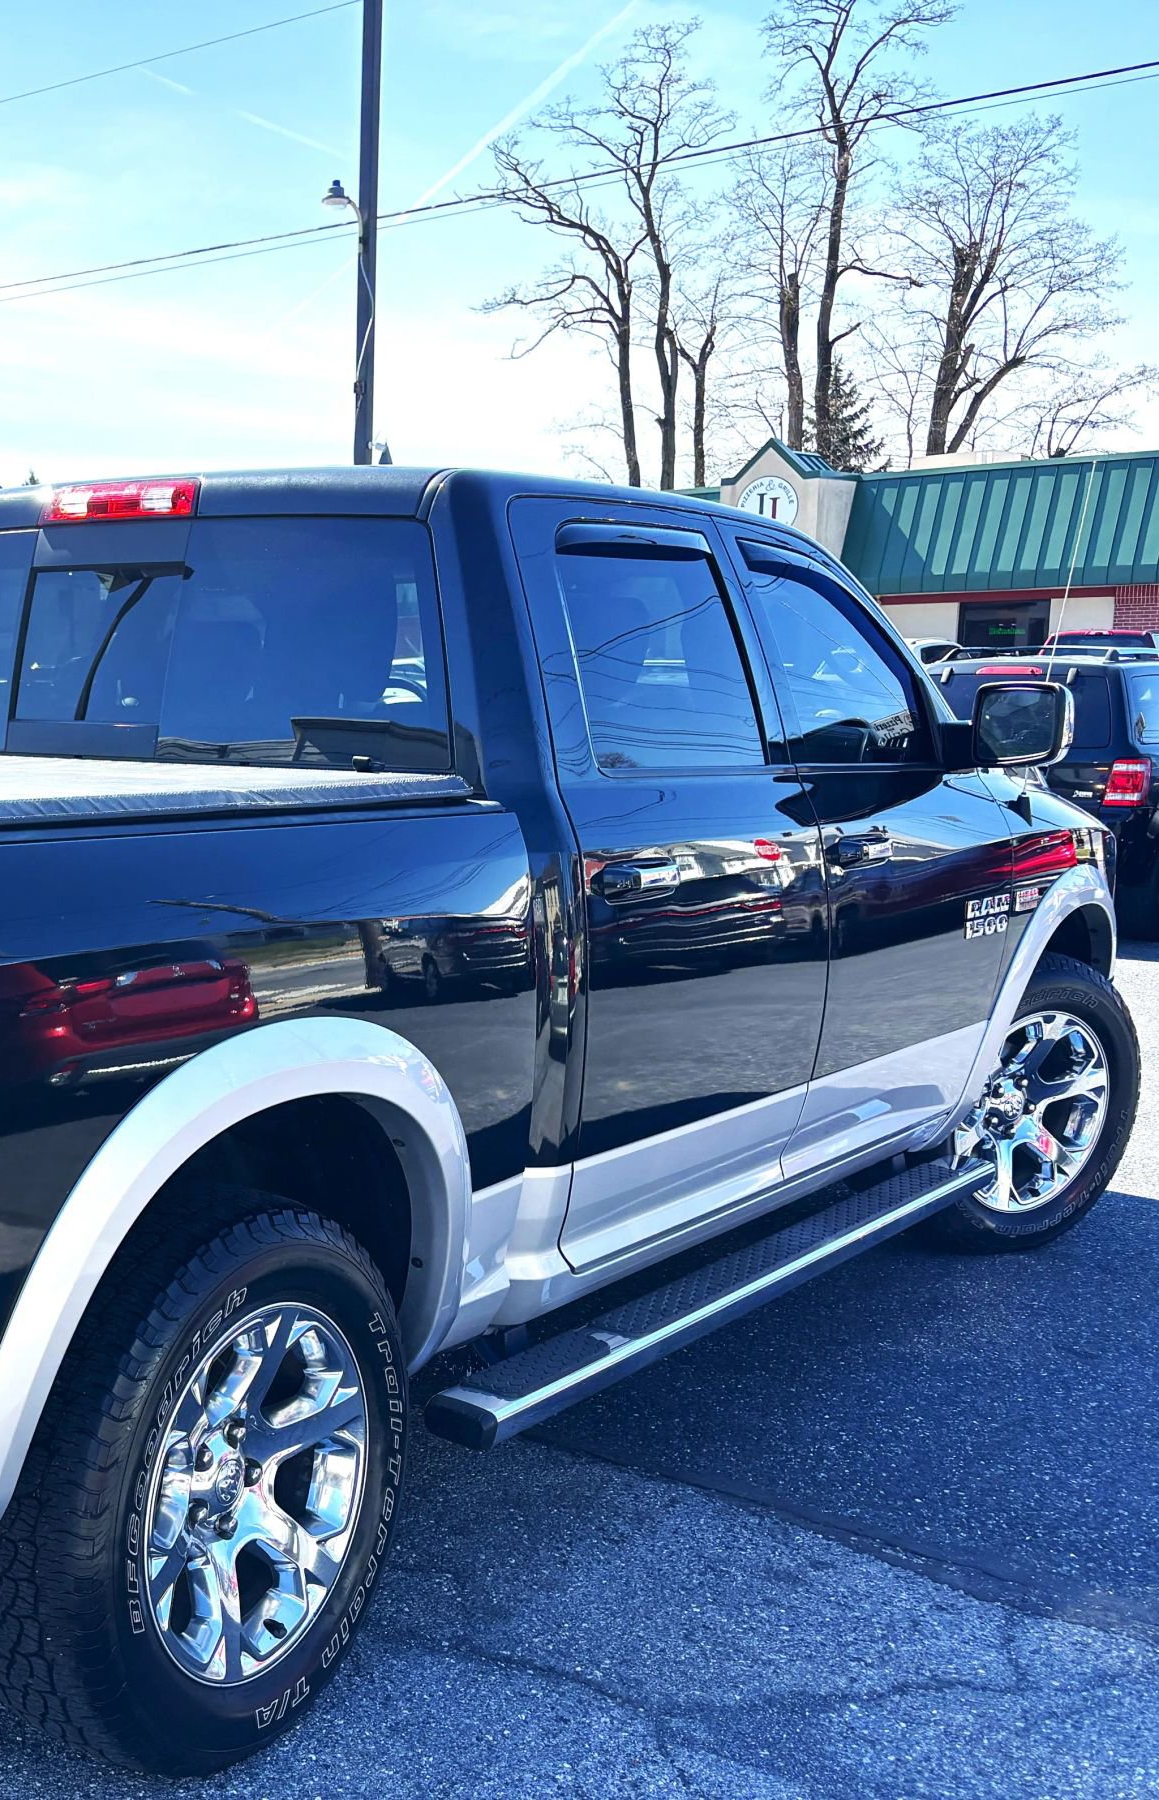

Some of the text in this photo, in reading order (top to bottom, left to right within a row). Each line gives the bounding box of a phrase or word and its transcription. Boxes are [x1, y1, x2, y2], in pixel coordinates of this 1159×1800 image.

[740, 479, 795, 508] PIZZERIA & GRILLE
[963, 914, 1008, 940] 1500
[965, 893, 1011, 920] RAM
[126, 1286, 248, 1635] BFGoodrich
[322, 1311, 404, 1670] Trail-Terrain
[255, 1675, 313, 1729] T/A
